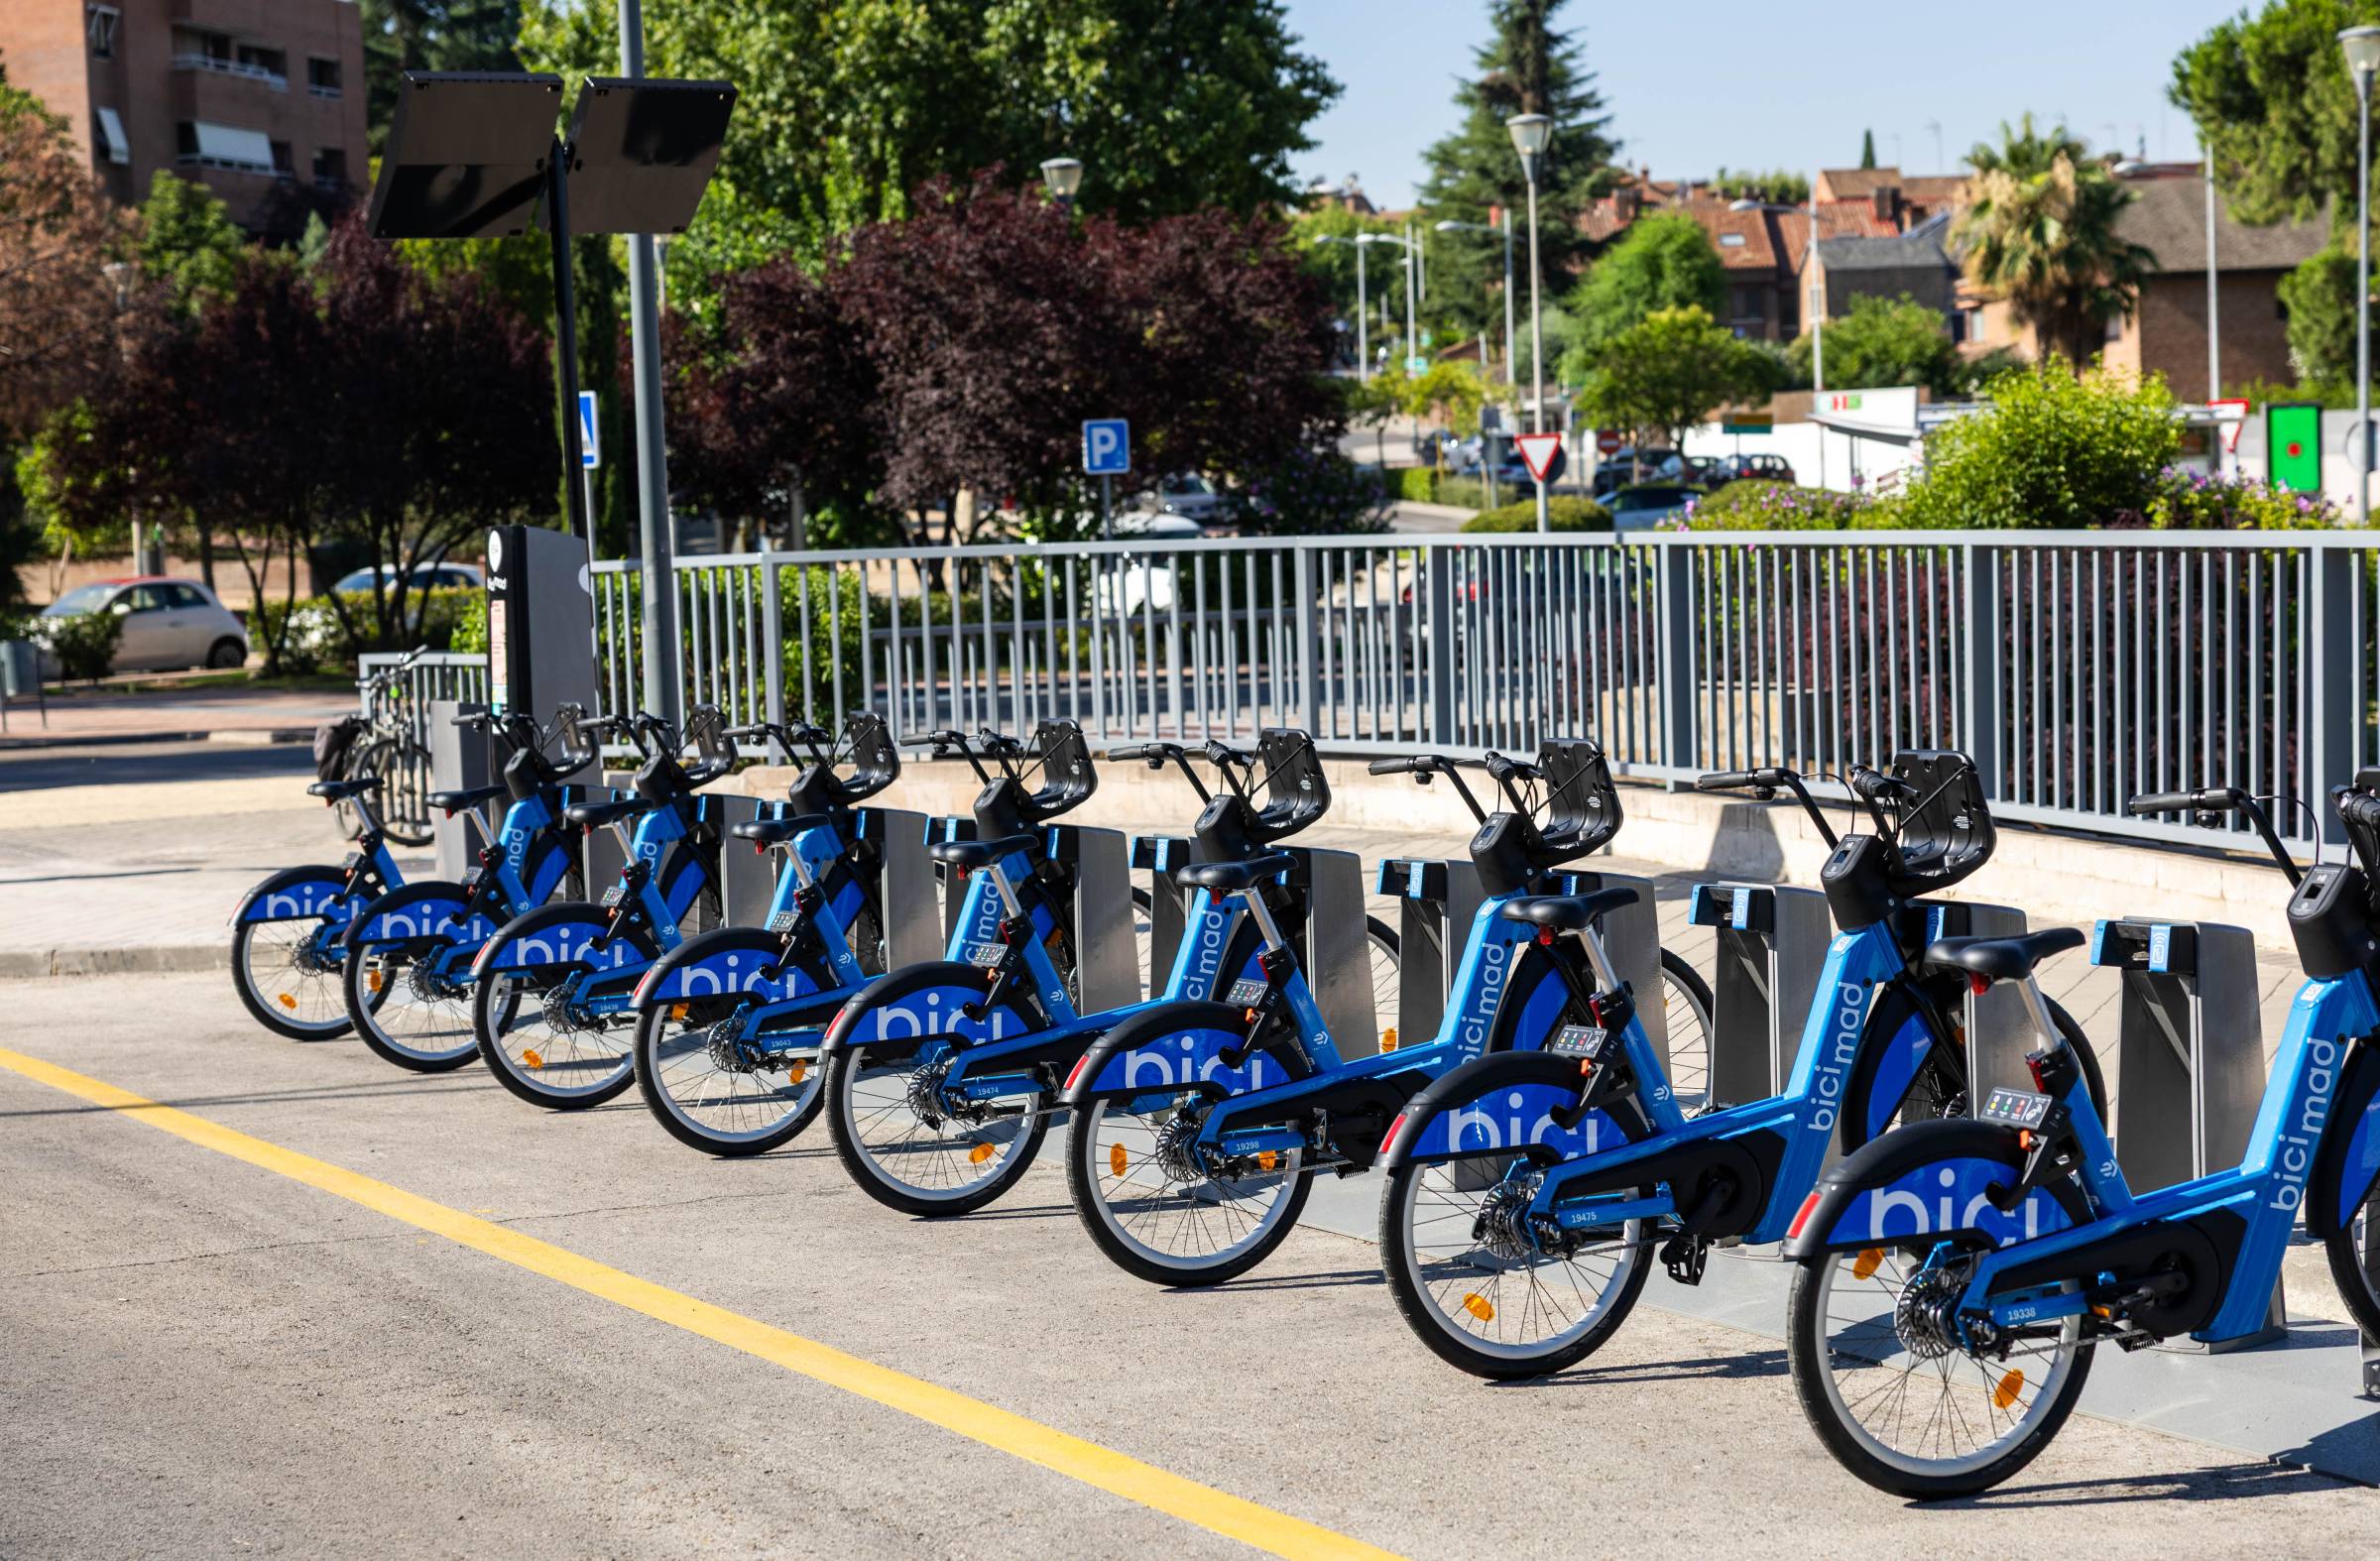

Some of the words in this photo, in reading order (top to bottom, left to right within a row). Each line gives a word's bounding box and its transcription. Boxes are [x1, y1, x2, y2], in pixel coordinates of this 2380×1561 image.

[1808, 981, 1863, 1132] bicimad
[977, 1086, 1000, 1096] 19474
[2270, 1036, 2335, 1211] bicimad
[1236, 1141, 1260, 1151] 19298
[1571, 1212, 1597, 1223] 19475
[2007, 1307, 2037, 1321] 19338
